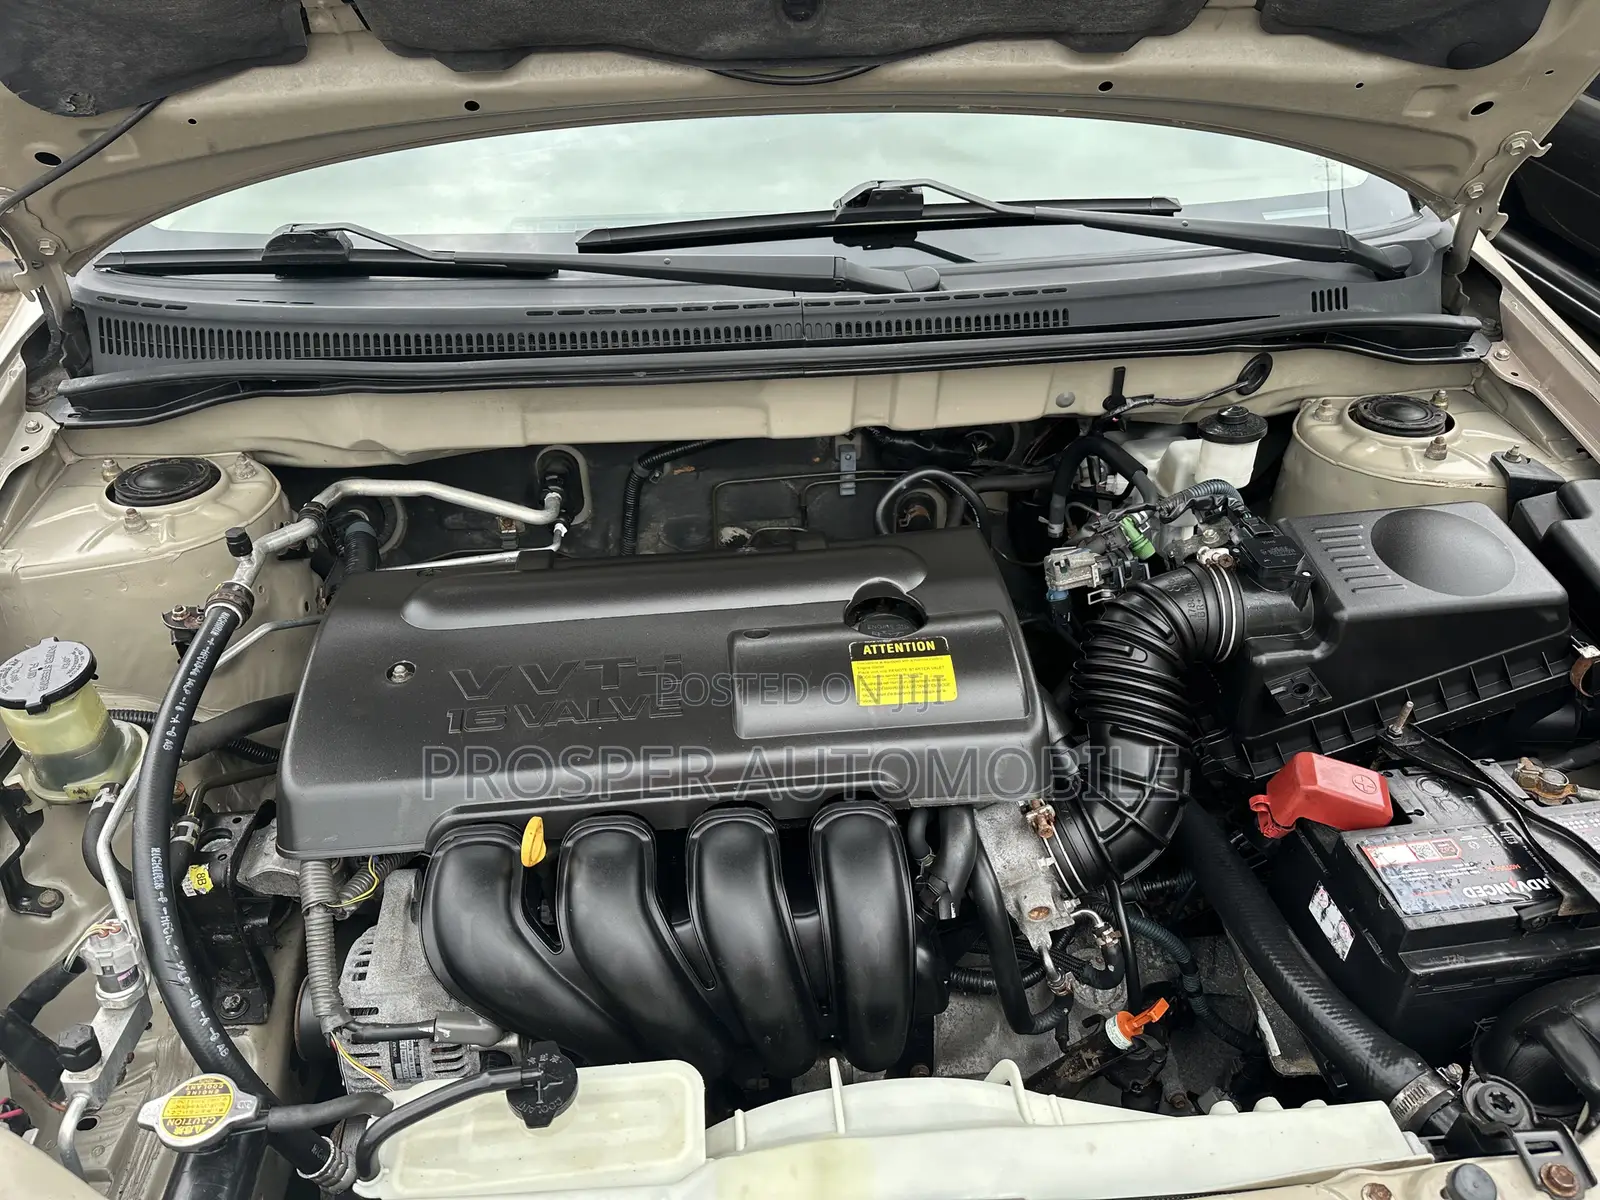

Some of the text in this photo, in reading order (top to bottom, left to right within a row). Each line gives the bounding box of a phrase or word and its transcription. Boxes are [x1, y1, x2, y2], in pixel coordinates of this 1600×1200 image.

[863, 640, 936, 655] ATTENTION
[449, 653, 683, 700] VVT-i
[446, 694, 683, 734] 16 VALVE
[196, 872, 207, 886] 8B
[1462, 877, 1551, 898] ADVANCED
[166, 1116, 216, 1126] CAUTION
